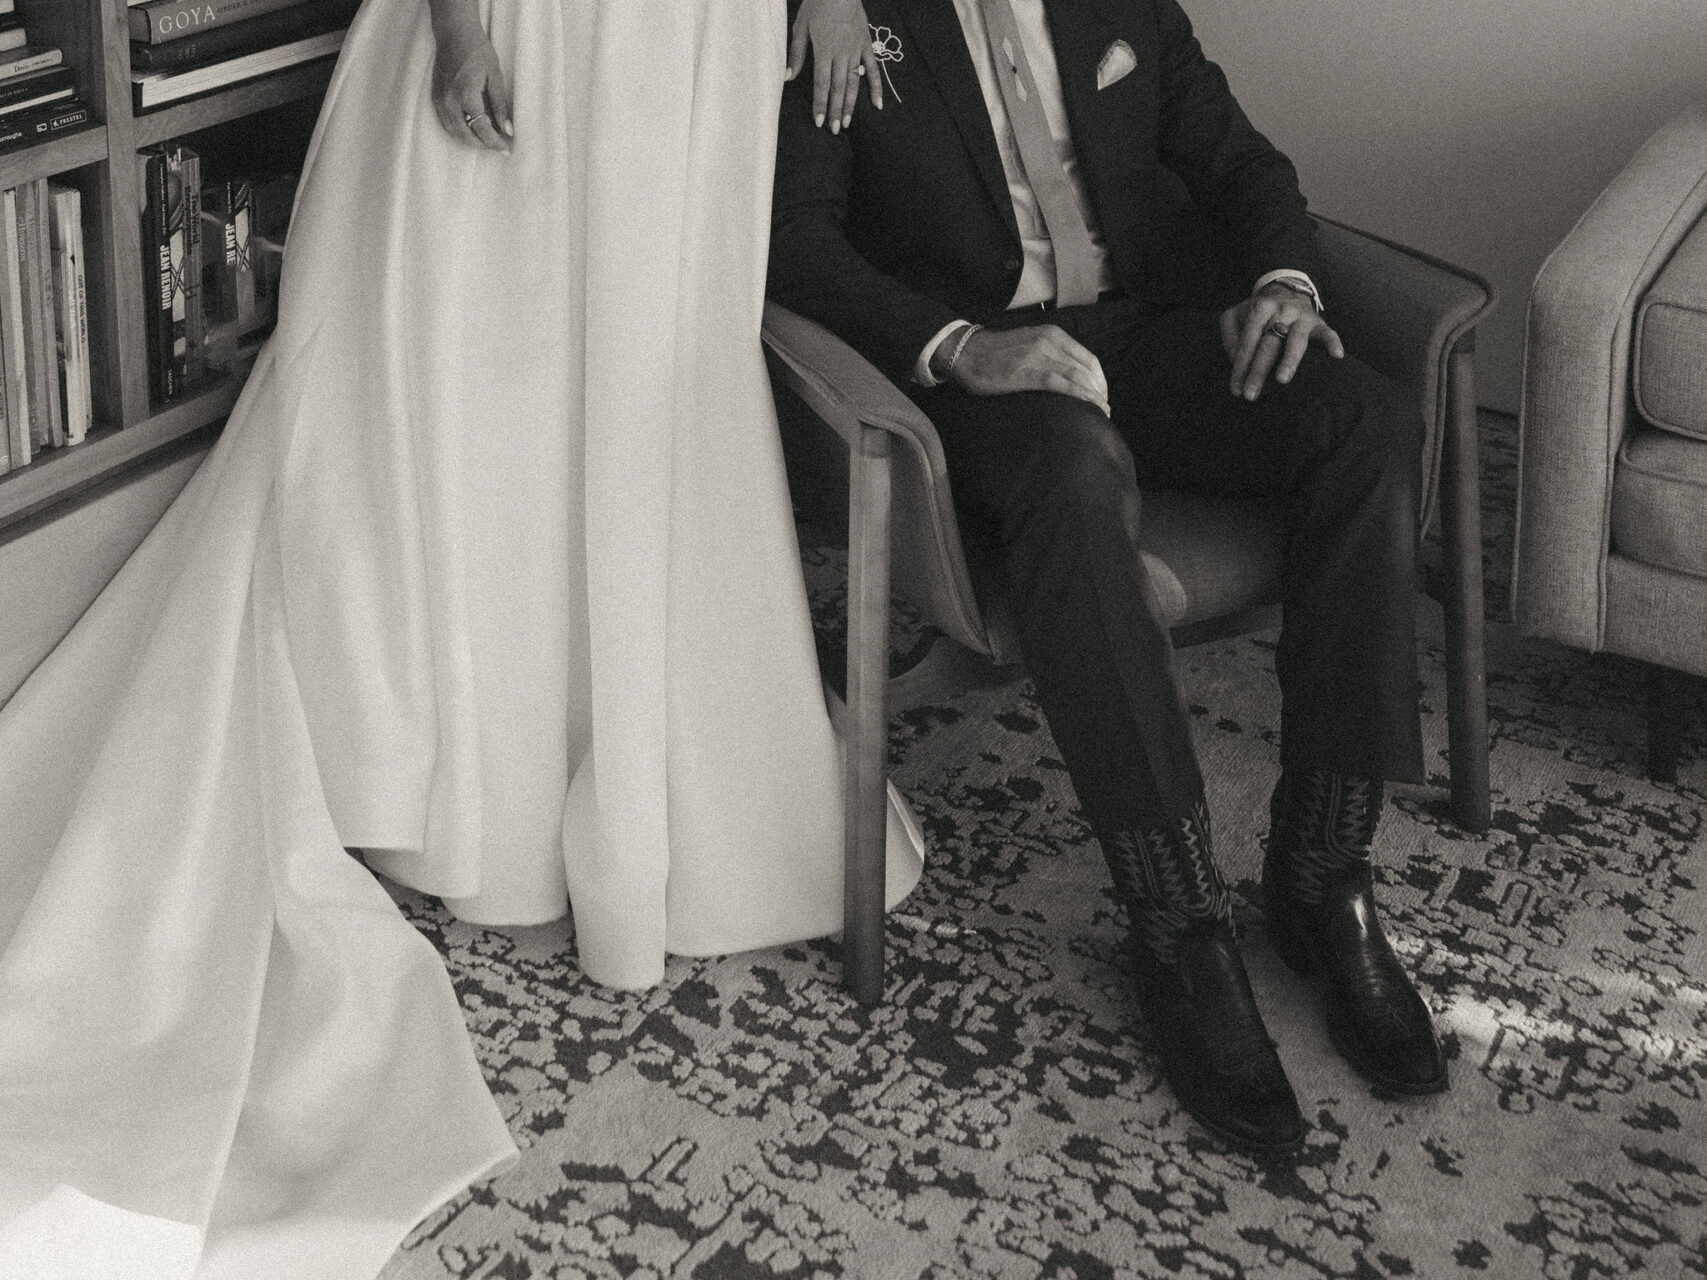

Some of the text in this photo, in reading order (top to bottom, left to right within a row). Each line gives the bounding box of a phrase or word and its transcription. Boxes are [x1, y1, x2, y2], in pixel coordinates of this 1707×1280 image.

[158, 5, 216, 34] GOYA
[59, 113, 84, 125] PRESTEL
[225, 223, 236, 248] JEAN
[158, 244, 171, 270] JEAN
[226, 249, 237, 266] RE
[160, 271, 173, 311] RENOIR
